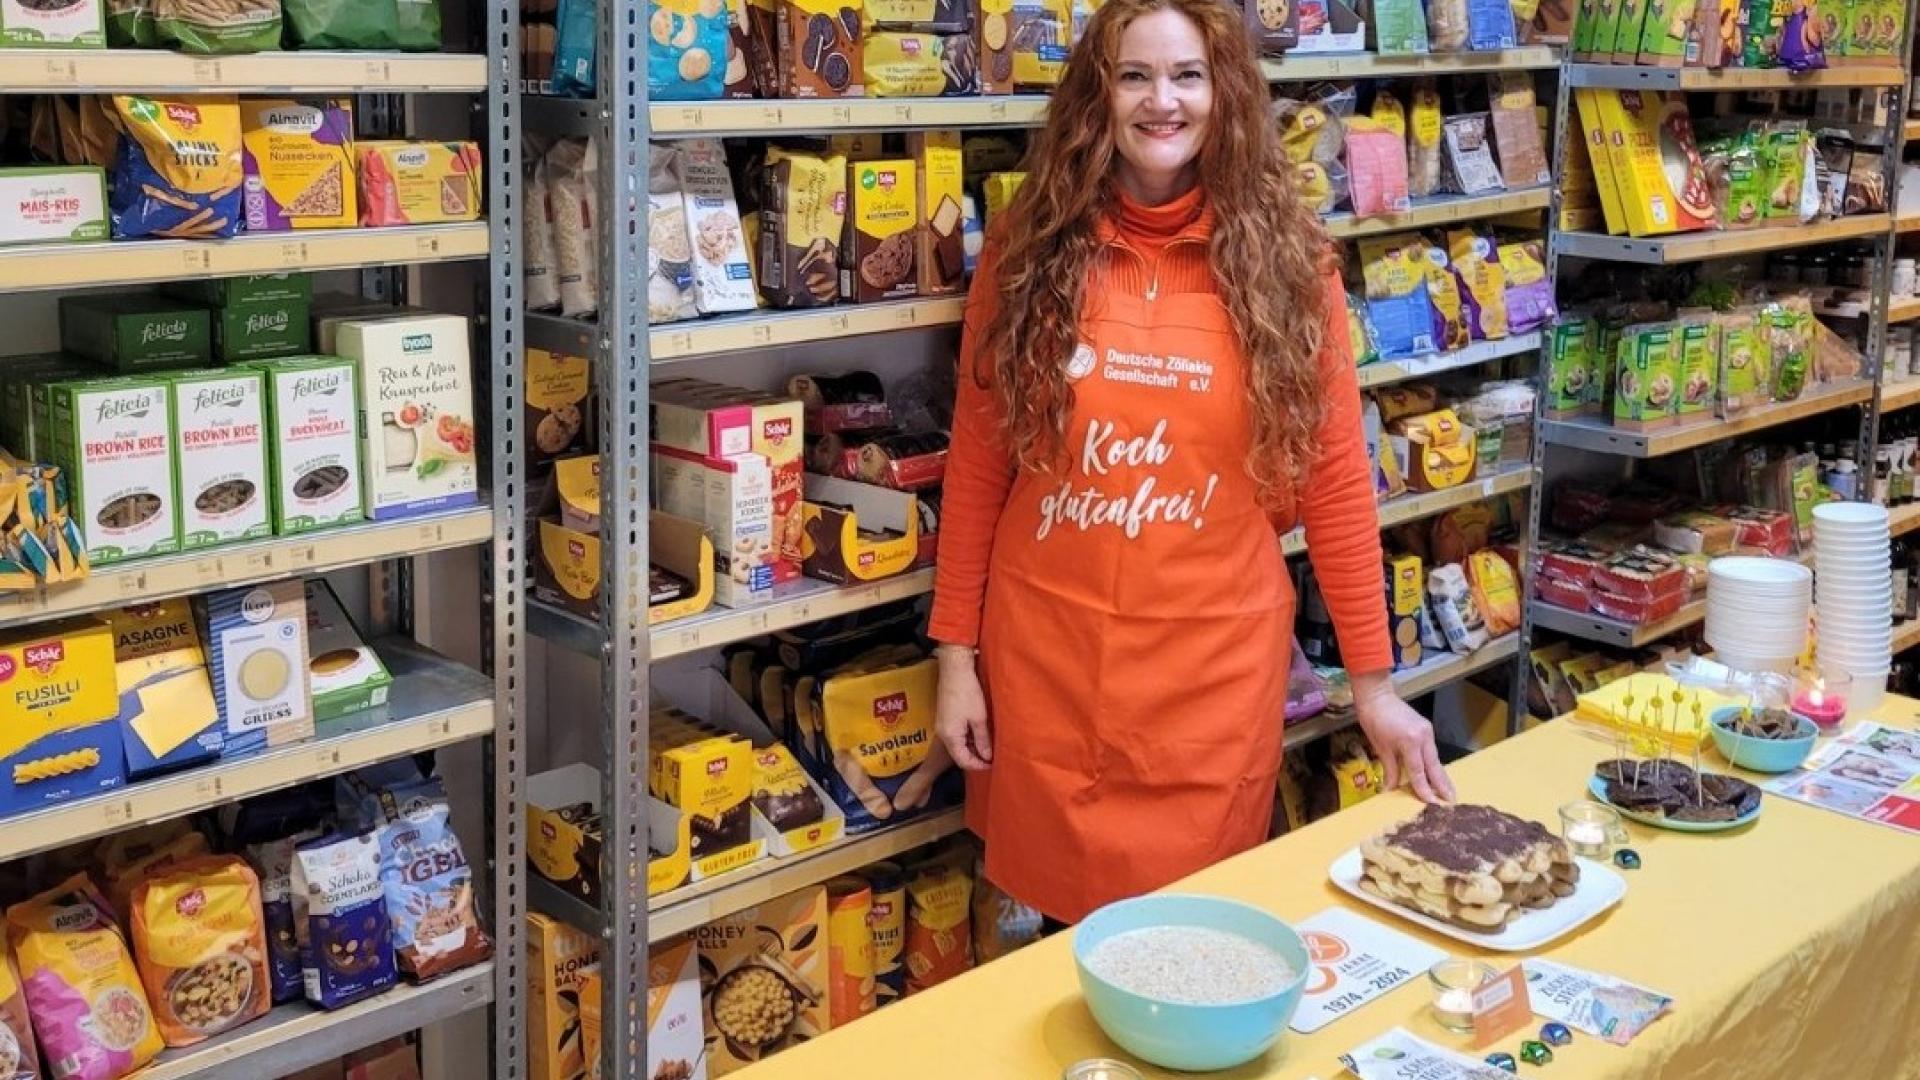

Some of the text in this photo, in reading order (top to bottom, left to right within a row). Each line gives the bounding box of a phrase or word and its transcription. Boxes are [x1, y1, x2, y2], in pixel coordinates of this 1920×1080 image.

[268, 112, 317, 125] Alnavit
[269, 151, 334, 161] Nussecken
[20, 198, 80, 214] MAIS-REIS
[141, 319, 187, 344] felicia
[245, 309, 289, 335] felicia
[379, 361, 456, 384] Reis & Mais
[1105, 347, 1214, 377] Deutsche Zöliakie
[290, 374, 339, 402] felicia
[379, 379, 458, 401] Knusperbrot
[1103, 366, 1212, 393] Gesellschaft e.V.
[95, 393, 151, 424] felicia
[192, 383, 245, 413] felicia
[86, 438, 135, 457] BROWN
[138, 435, 166, 450] RICE
[184, 424, 259, 445] BROWN RICE
[1081, 417, 1174, 477] Koch
[1035, 473, 1219, 541] glutenfrei!
[118, 622, 190, 648] ASAGNE
[26, 646, 62, 663] Schär
[15, 679, 81, 705] FUSILLI
[242, 706, 293, 726] GRIESS
[876, 698, 905, 713] Schär
[858, 728, 928, 757] Savoiardi
[327, 866, 372, 893] Schoko
[686, 925, 747, 941] HONEY
[697, 939, 729, 950] ALLS
[553, 950, 600, 976] HONE
[1321, 990, 1363, 1014] 1974
[1368, 966, 1411, 990] 2024
